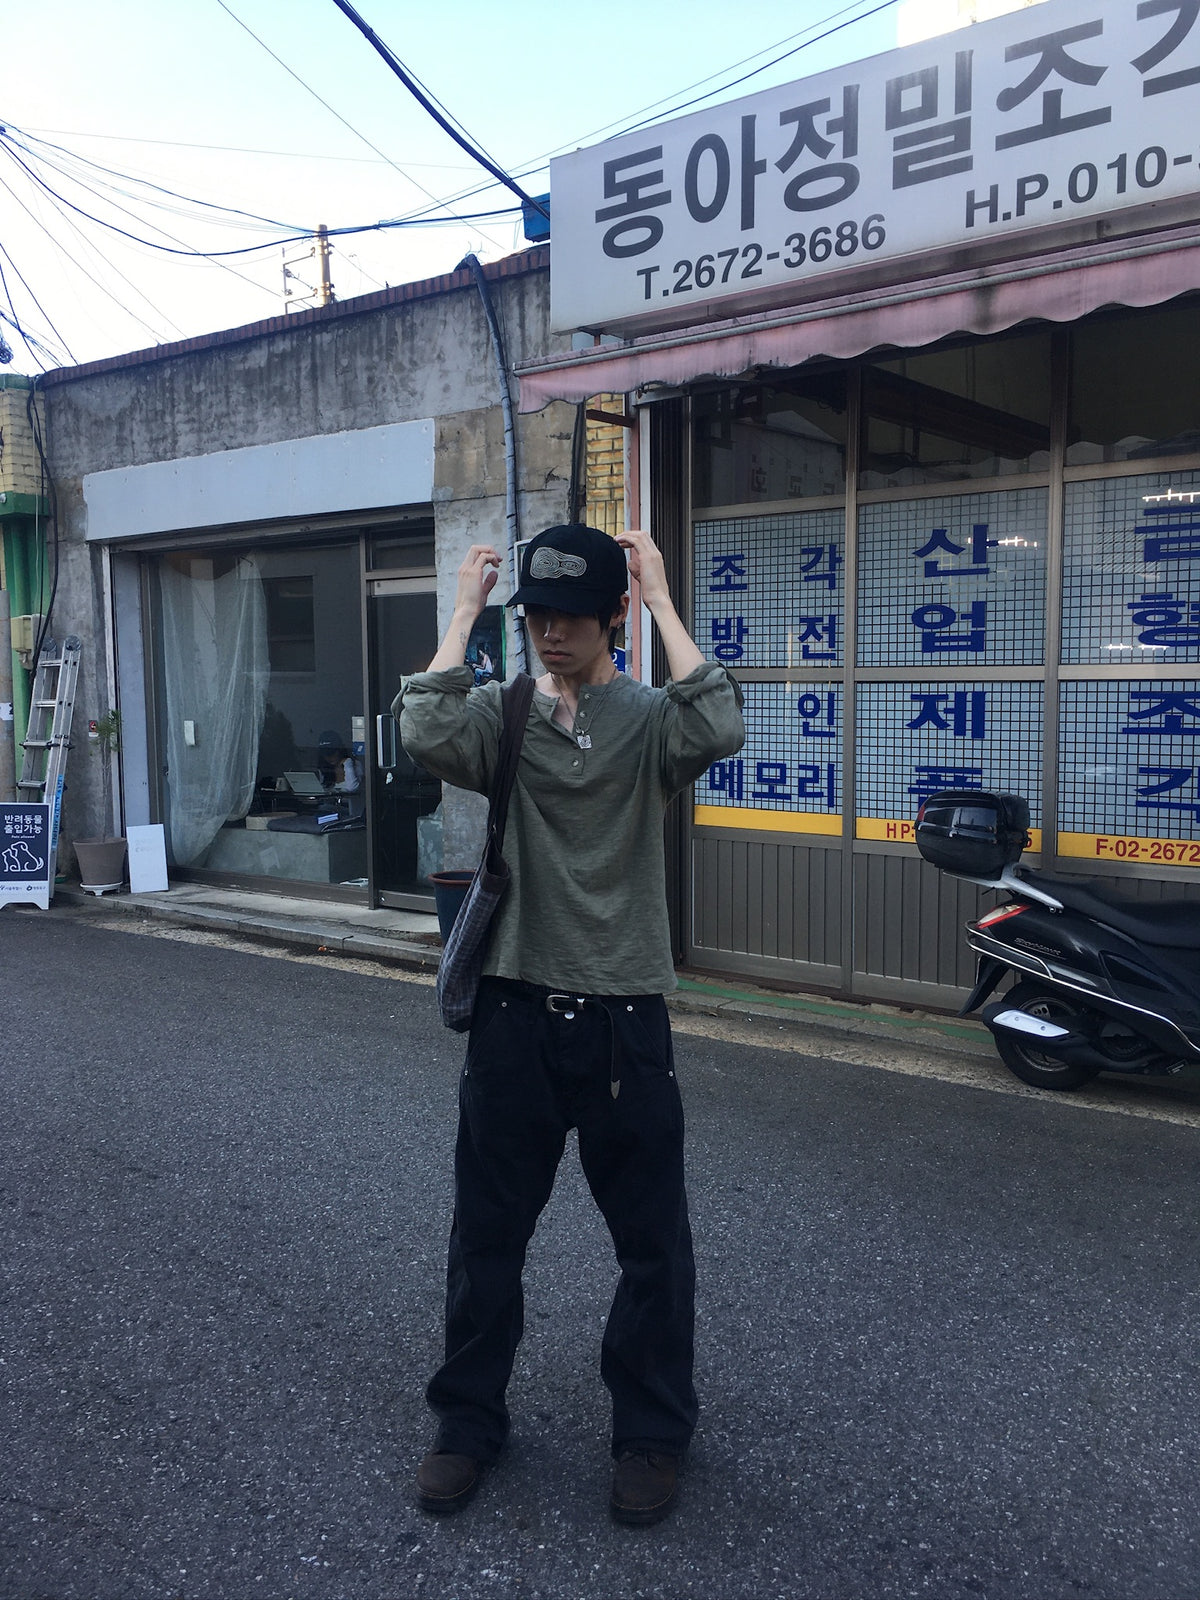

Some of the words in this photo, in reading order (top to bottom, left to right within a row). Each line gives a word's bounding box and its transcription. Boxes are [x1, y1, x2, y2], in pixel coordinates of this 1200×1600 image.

[966, 144, 1200, 228] H.P.010-
[636, 213, 887, 300] T.2672-3686
[709, 759, 836, 808] 메모리
[4, 814, 43, 825] 반려동물
[4, 824, 43, 834] 출입가능
